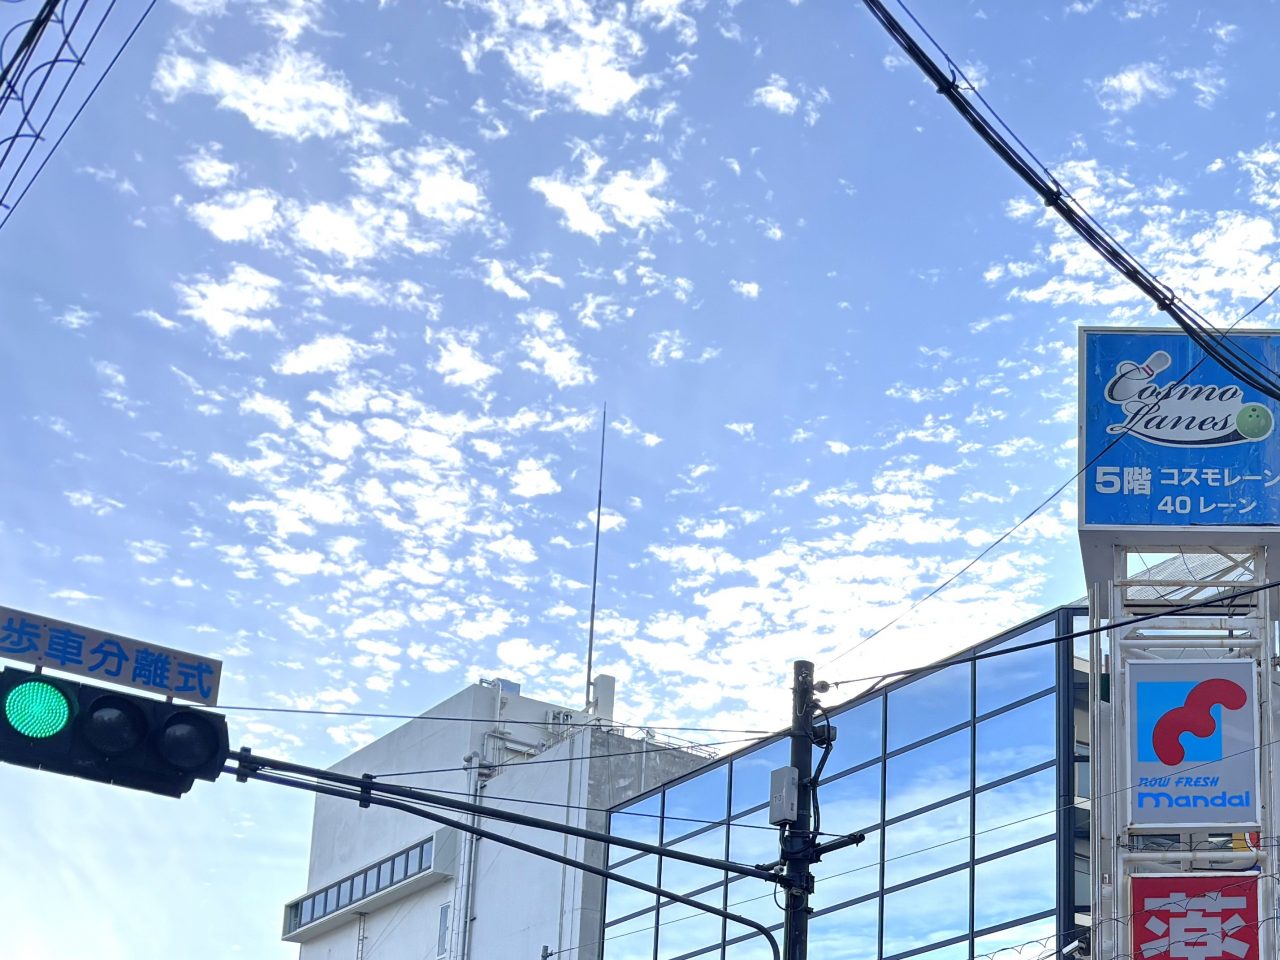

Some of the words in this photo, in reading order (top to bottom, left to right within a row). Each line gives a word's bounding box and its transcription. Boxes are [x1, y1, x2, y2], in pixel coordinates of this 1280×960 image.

[1107, 362, 1242, 402] Cosmo
[1110, 401, 1236, 432] Lanes
[1095, 466, 1152, 495] 5階
[1160, 468, 1280, 488] コスモレーン
[0, 616, 214, 700] 歩車分離式
[1175, 776, 1219, 787] FRESH
